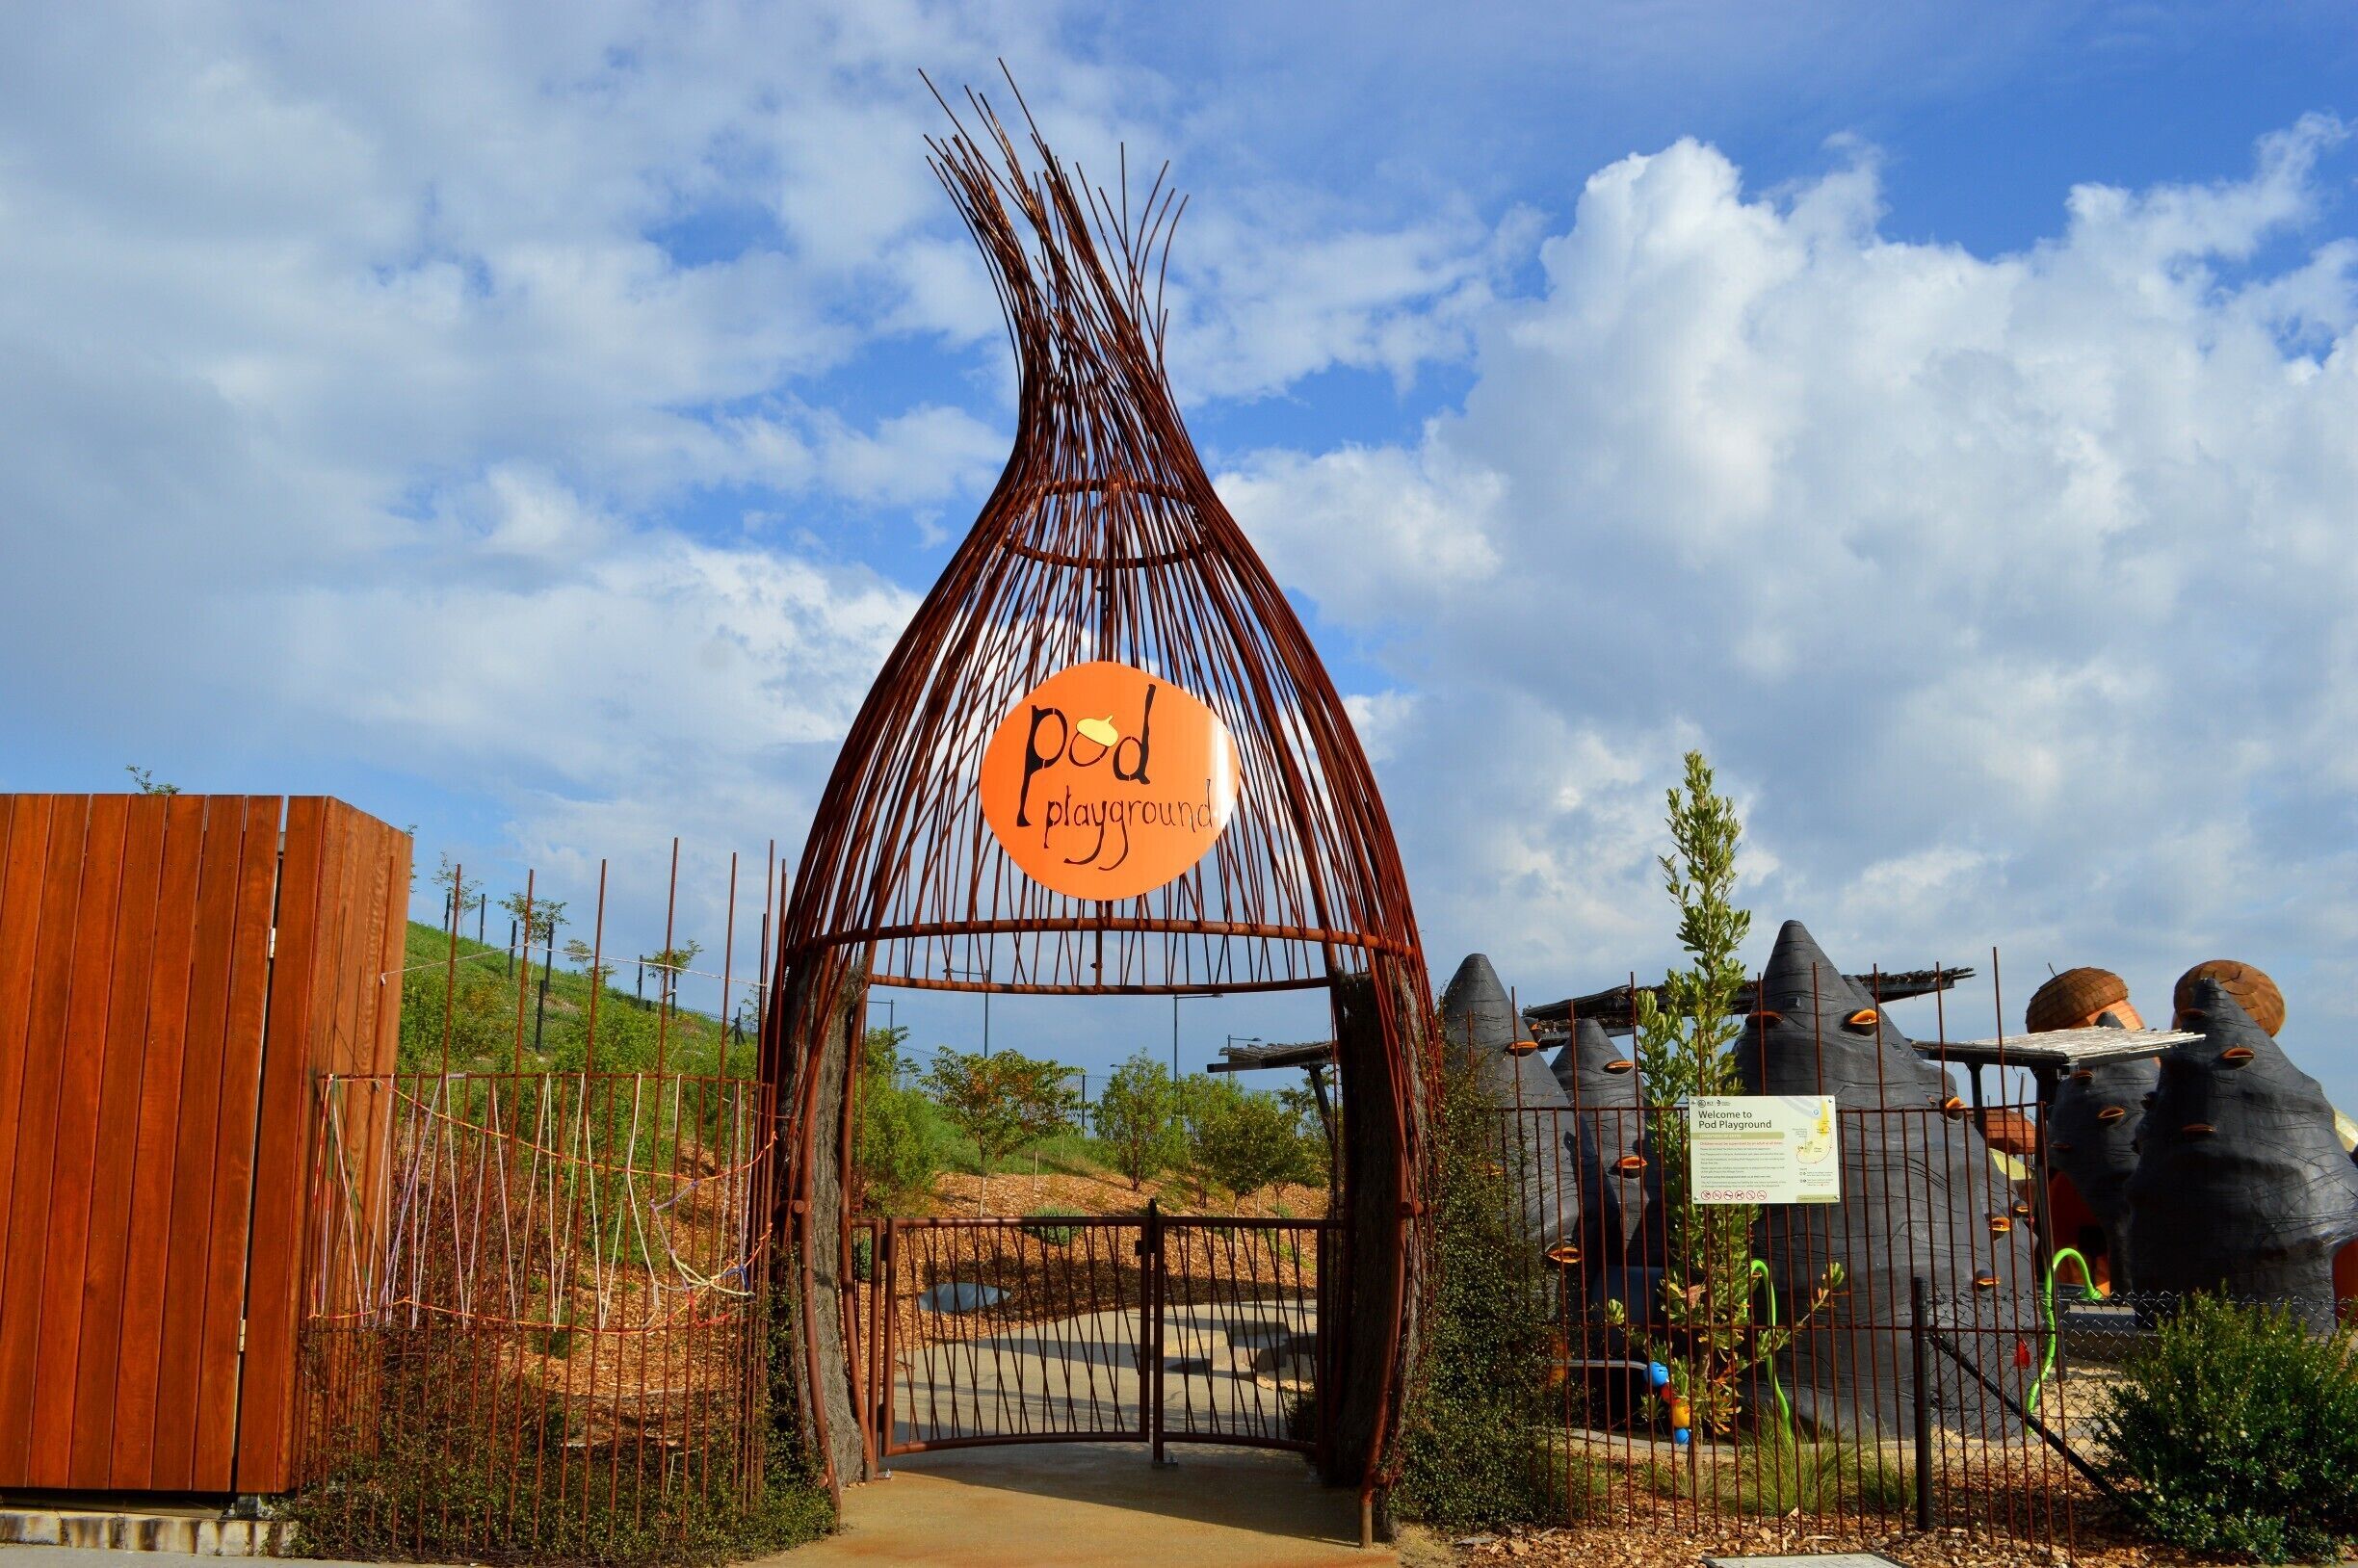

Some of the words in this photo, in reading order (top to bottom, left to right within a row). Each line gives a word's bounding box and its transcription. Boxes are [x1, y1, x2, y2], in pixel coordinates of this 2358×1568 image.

[1016, 684, 1157, 827] pod
[1043, 778, 1214, 871] playground
[1698, 1110, 1741, 1119] Welcome
[1742, 1111, 1753, 1119] to
[1698, 1120, 1717, 1129] Pod
[1718, 1120, 1772, 1131] Playground
